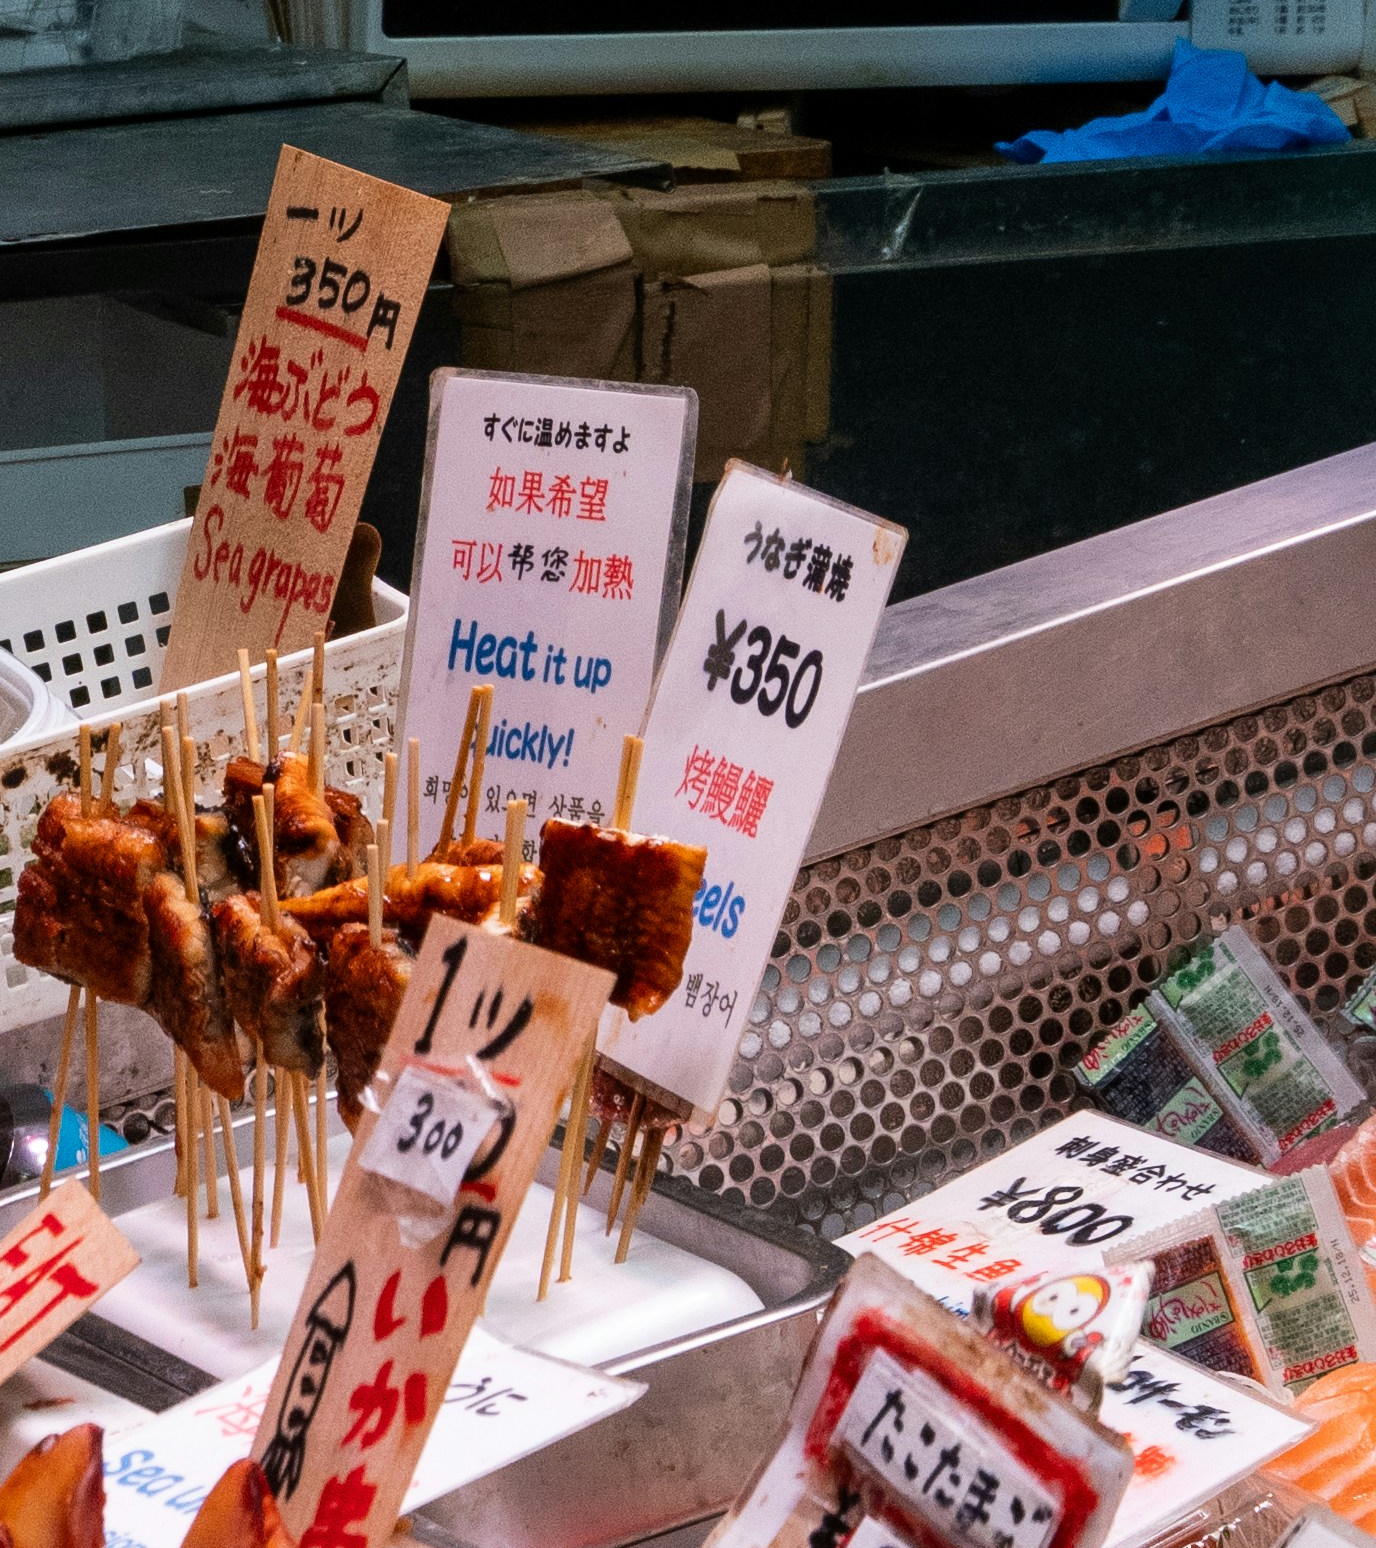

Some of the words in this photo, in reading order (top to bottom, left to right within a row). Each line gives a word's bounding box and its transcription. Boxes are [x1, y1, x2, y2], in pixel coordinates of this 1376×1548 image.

[232, 333, 382, 437] 海ぶどう
[481, 409, 633, 455] すぐに温めますよ
[209, 424, 346, 534] 海葡萄
[486, 467, 609, 525] 如果希望
[193, 502, 244, 584] Sea
[238, 546, 336, 650] grapes
[449, 616, 539, 684] Heat
[542, 645, 570, 684] it
[571, 652, 615, 696] up
[703, 609, 825, 730] ¥350
[683, 972, 739, 1029] 뱀장어
[397, 1090, 462, 1162] 300
[1054, 1135, 1217, 1203] 刺身盛合わせ
[976, 1176, 1135, 1248] ¥800
